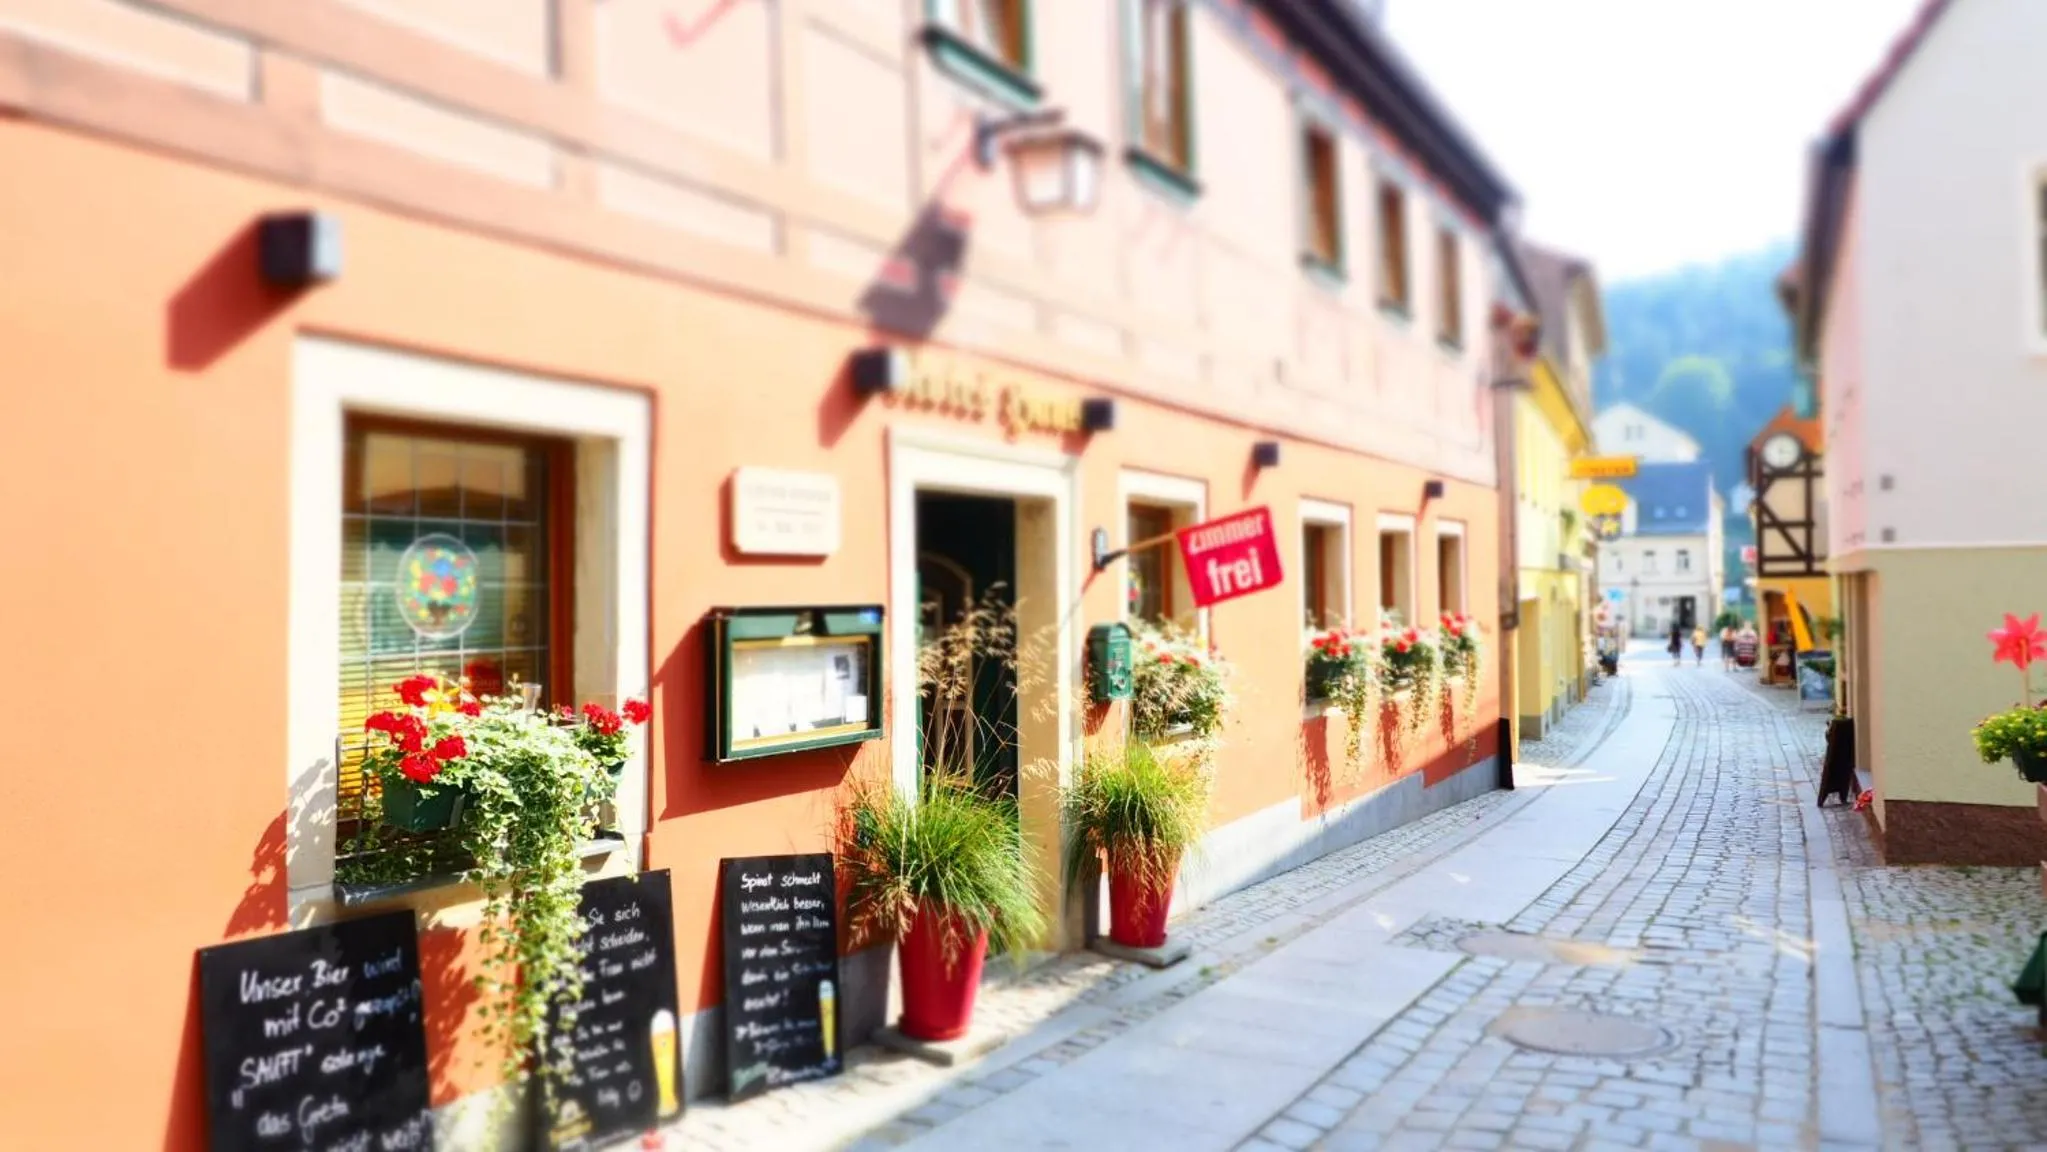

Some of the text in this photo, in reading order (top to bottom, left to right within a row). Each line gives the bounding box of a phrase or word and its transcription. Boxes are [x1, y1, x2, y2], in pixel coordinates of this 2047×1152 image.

[1207, 547, 1264, 597] frei
[614, 901, 640, 922] sich
[240, 969, 303, 1004] Unser
[310, 959, 350, 988] Bier
[264, 1001, 300, 1038] mit
